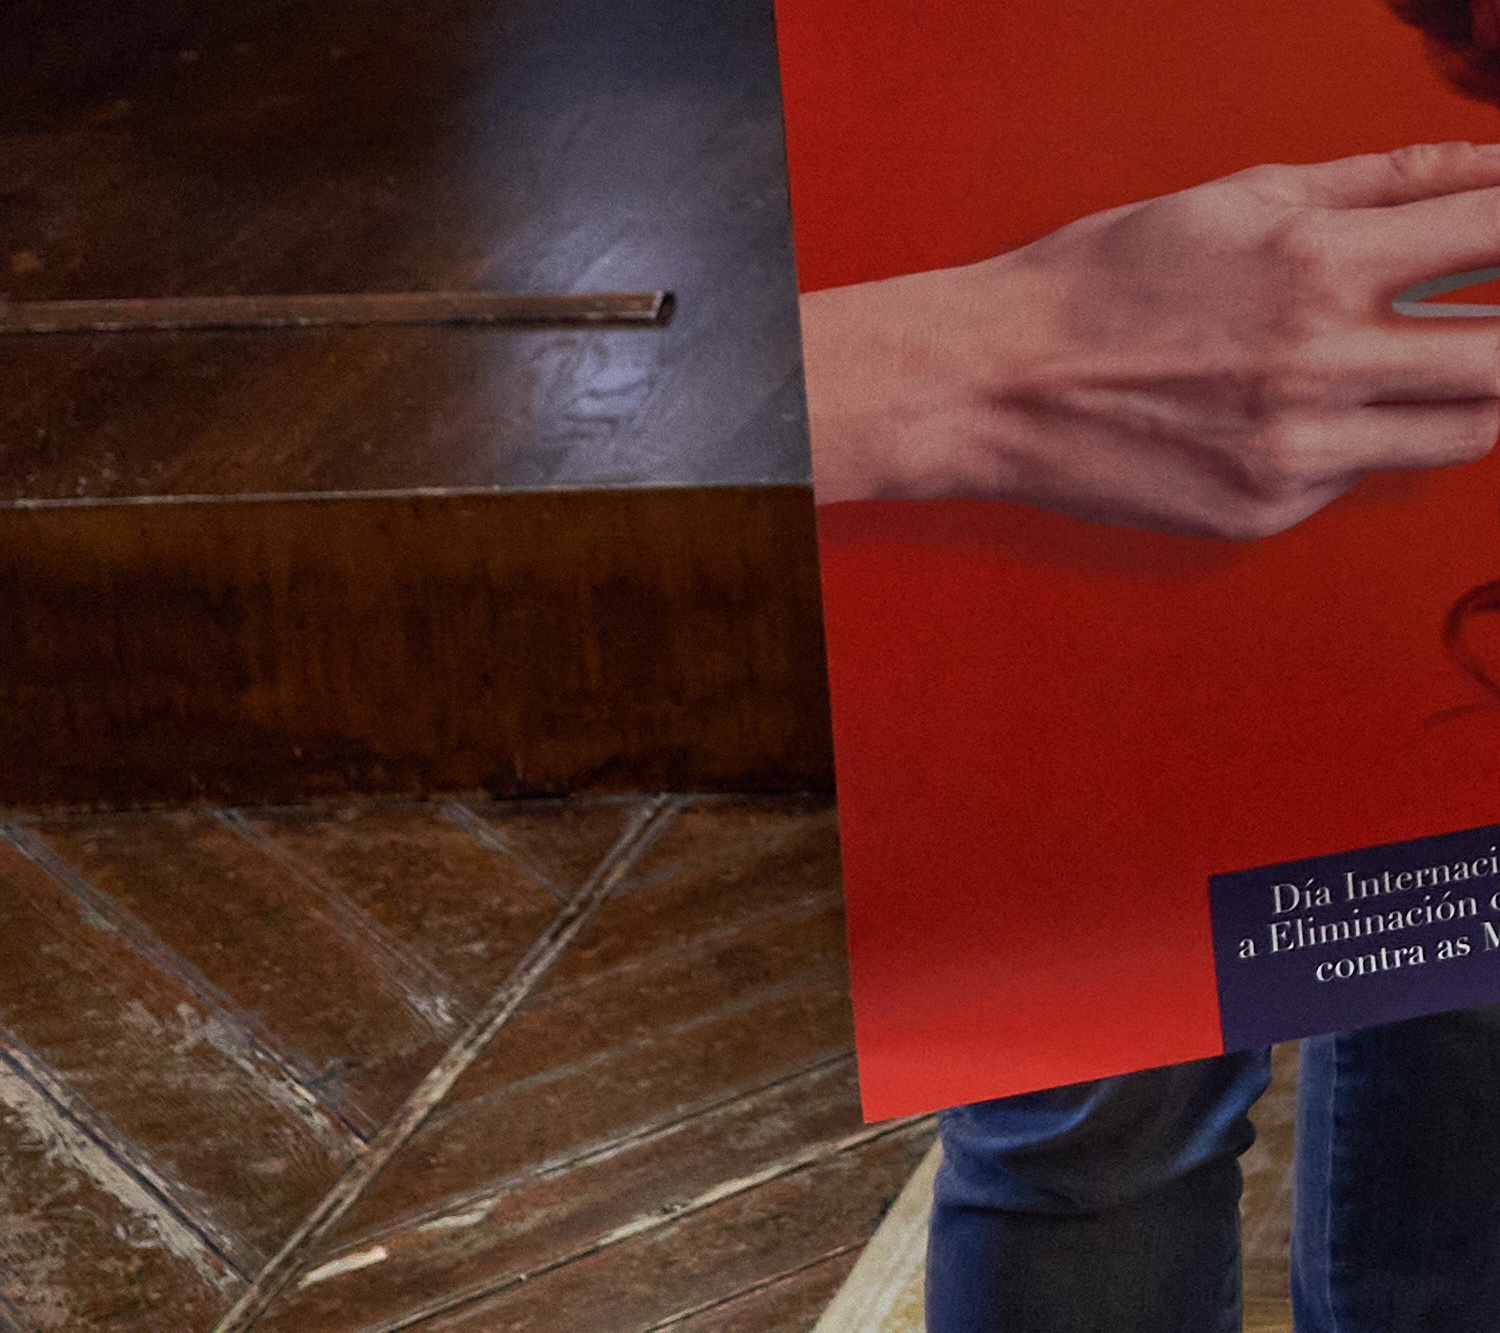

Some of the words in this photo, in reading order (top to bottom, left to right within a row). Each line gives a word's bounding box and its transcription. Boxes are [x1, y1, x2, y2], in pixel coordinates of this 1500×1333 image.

[1273, 878, 1331, 914] Día
[1238, 938, 1256, 959] a
[1270, 890, 1477, 952] Eliminación
[1315, 945, 1425, 981] contra
[1436, 936, 1471, 960] as
